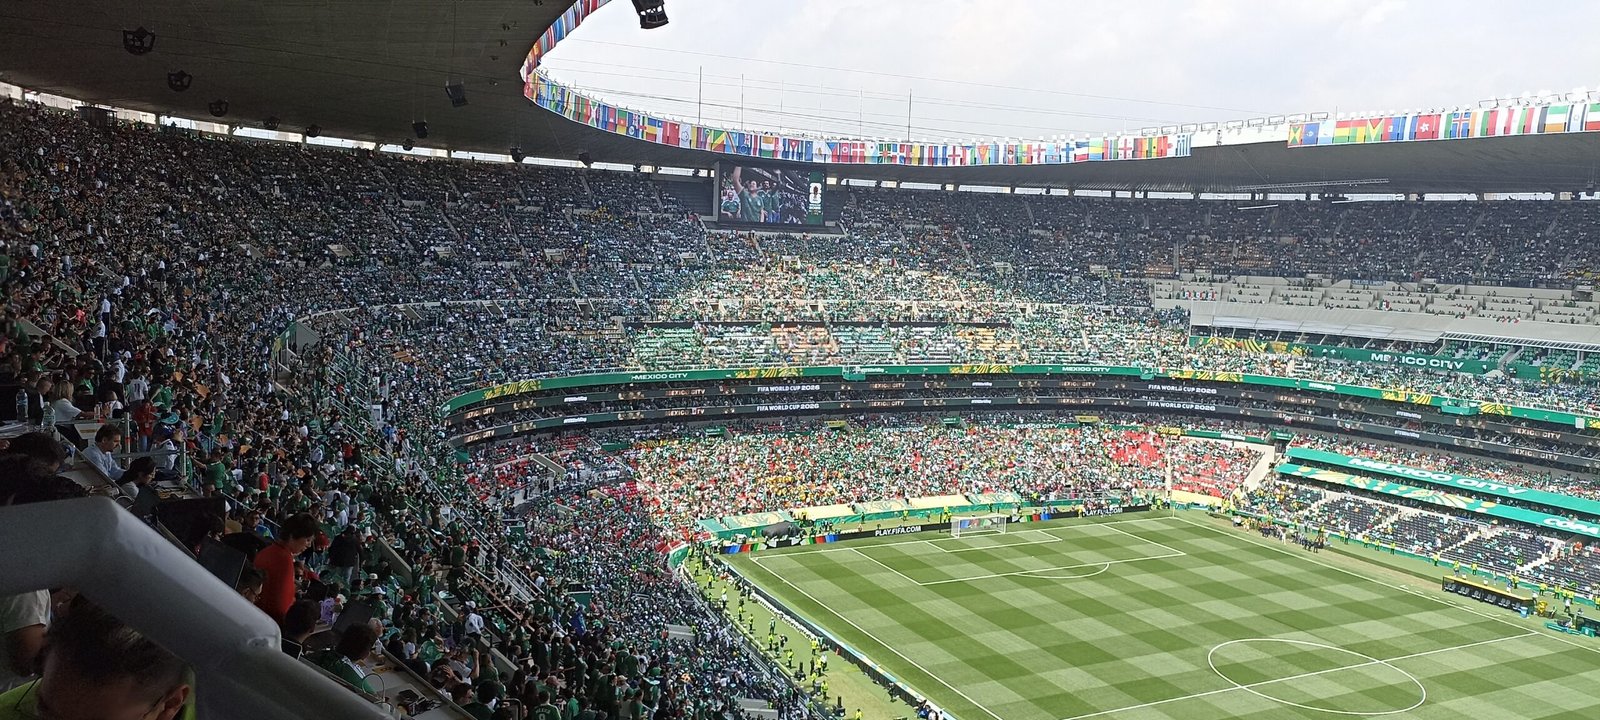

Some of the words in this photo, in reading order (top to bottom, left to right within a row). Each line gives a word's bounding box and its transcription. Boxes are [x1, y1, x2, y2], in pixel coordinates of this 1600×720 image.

[1429, 359, 1464, 369] CITY
[1542, 431, 1561, 440] CITY
[1540, 452, 1559, 461] CITY
[1348, 458, 1453, 482] MEXICO
[1456, 478, 1529, 495] CITY
[875, 525, 922, 537] PLAY.FIFA.COM
